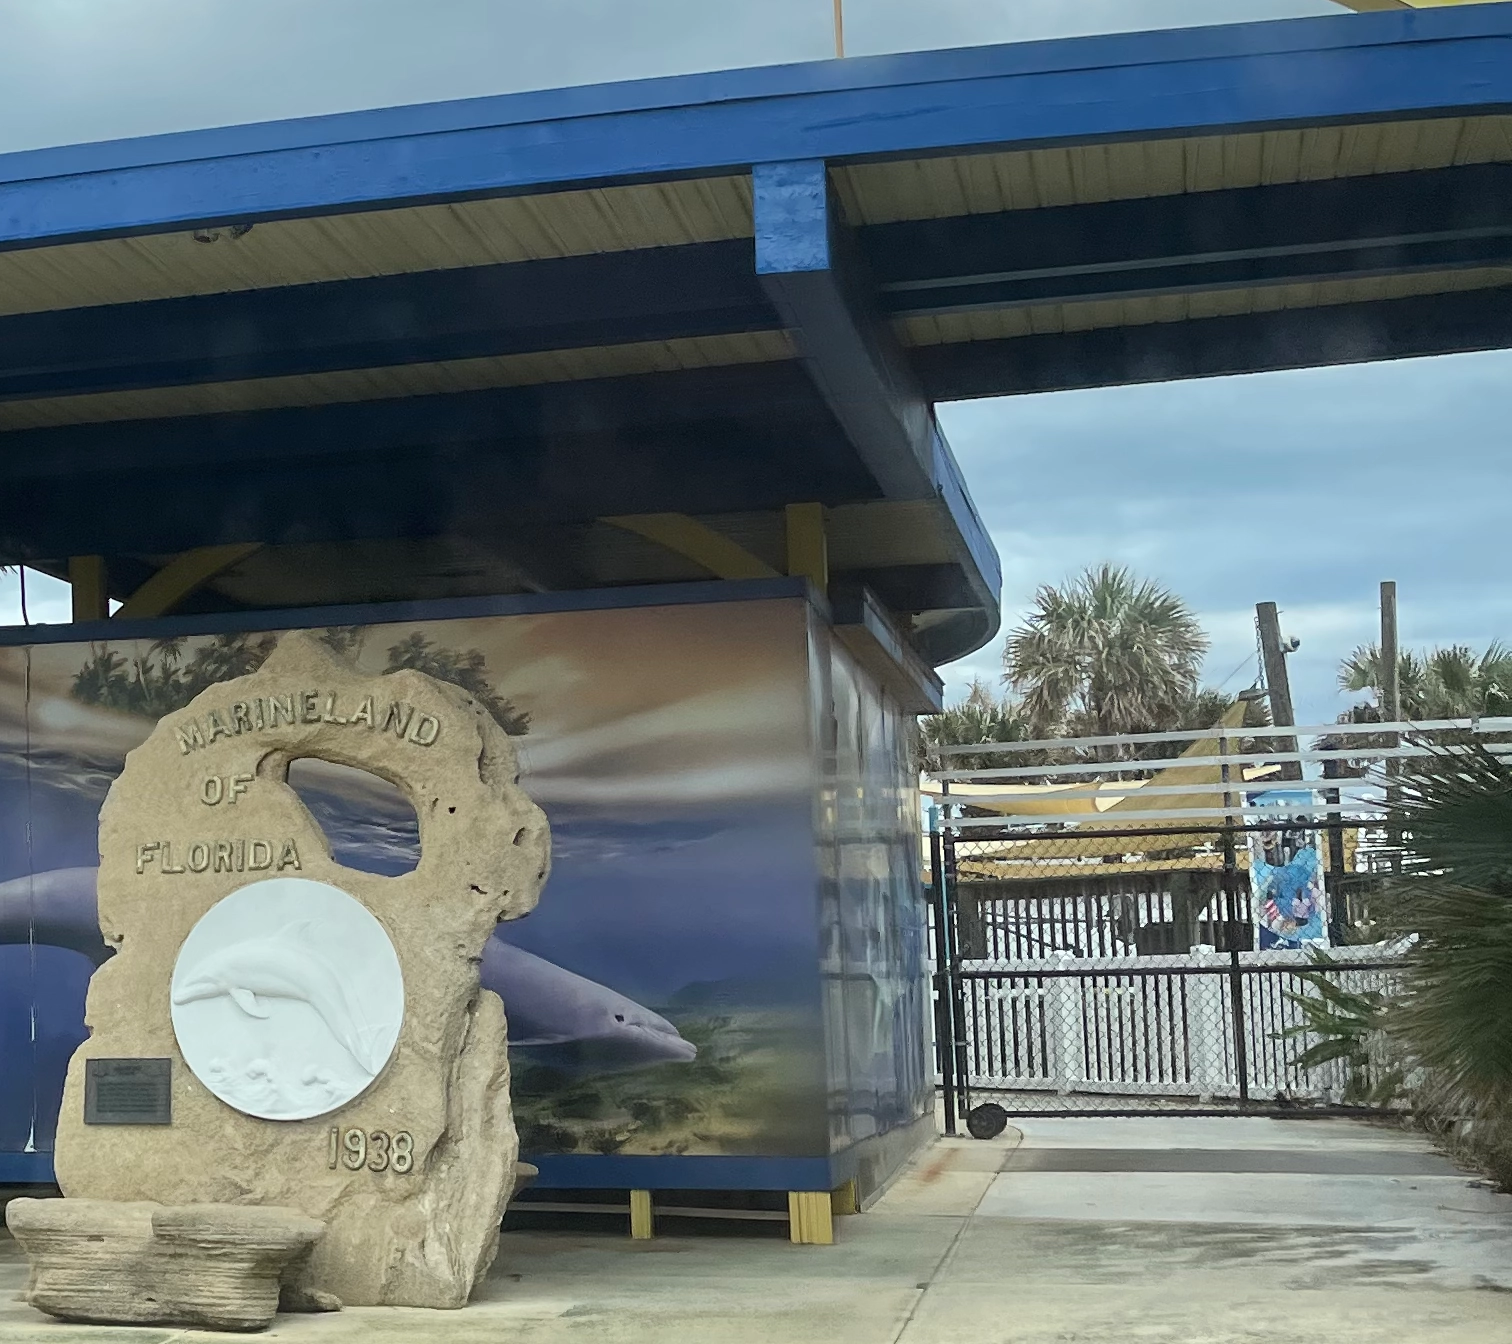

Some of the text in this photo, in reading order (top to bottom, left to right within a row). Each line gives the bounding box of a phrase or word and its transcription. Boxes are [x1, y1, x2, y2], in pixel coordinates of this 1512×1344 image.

[174, 688, 441, 756] MARINELAND
[200, 772, 255, 806] OF
[136, 837, 303, 875] FLORIDA
[328, 1126, 415, 1175] 1938
